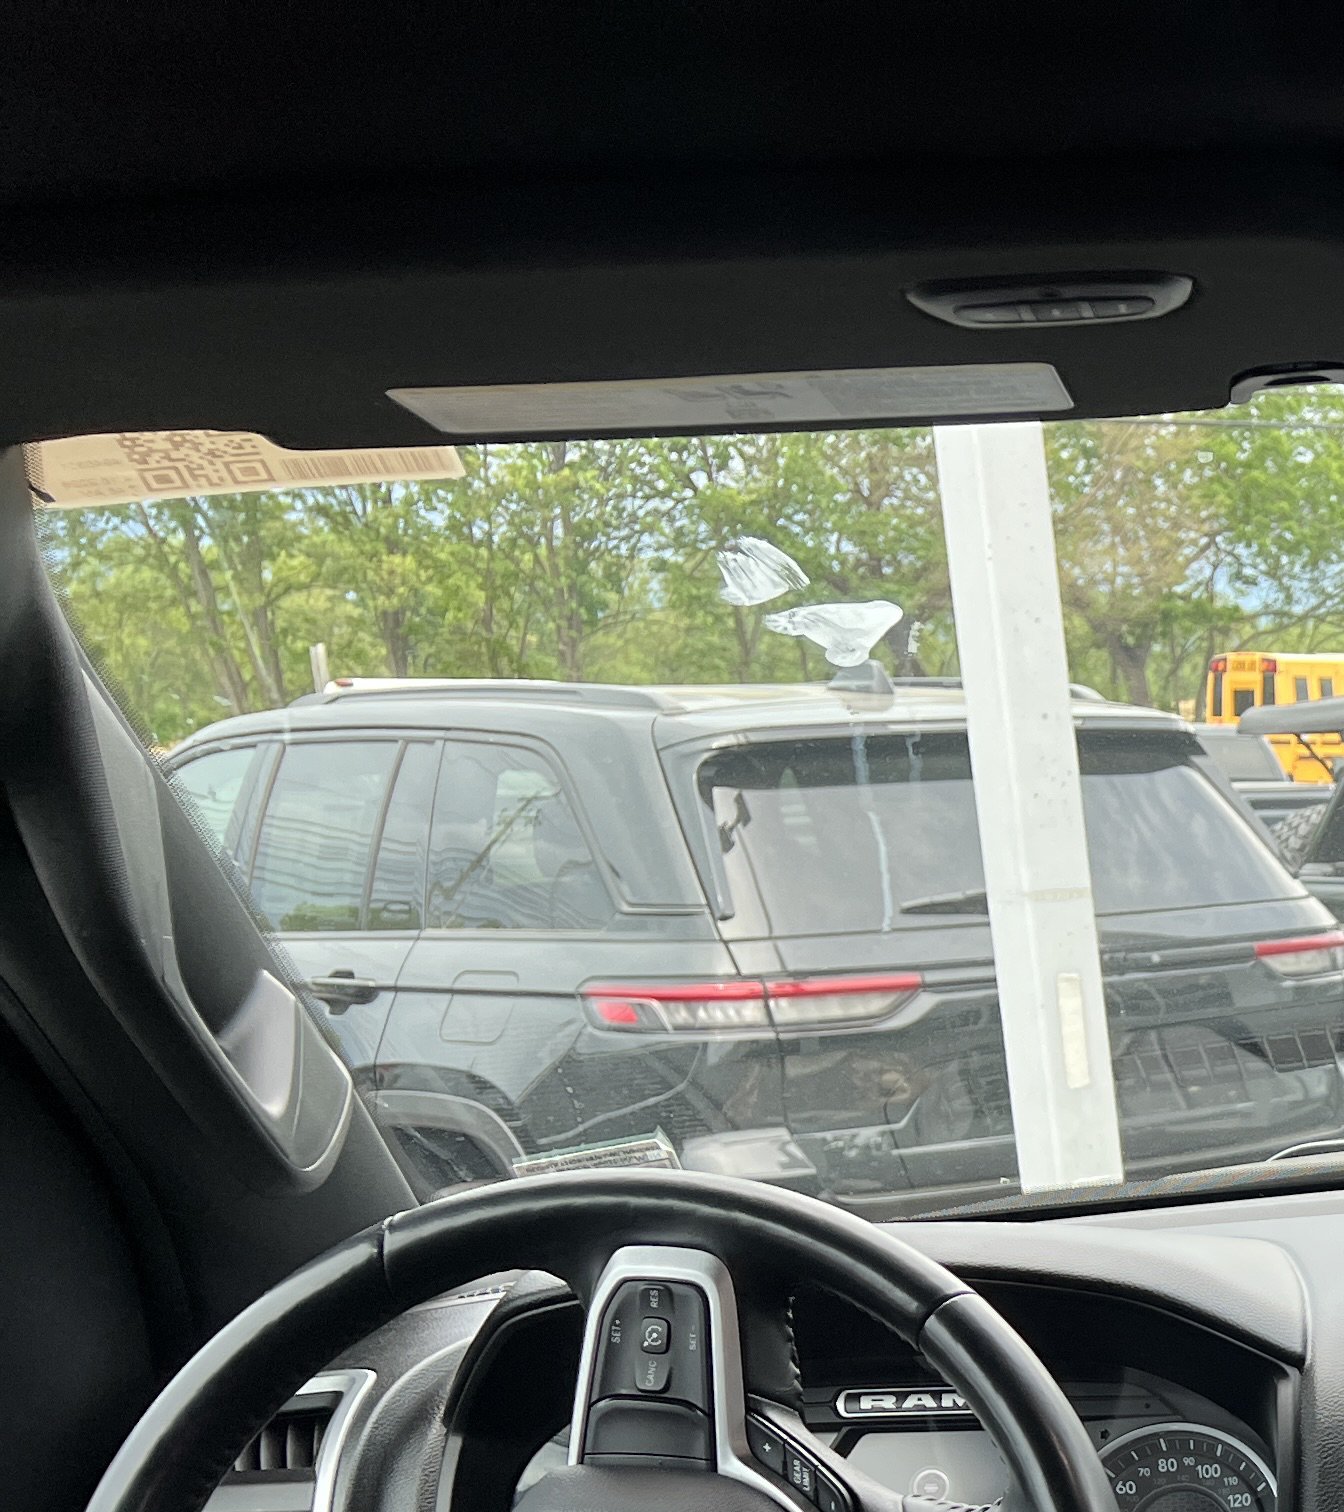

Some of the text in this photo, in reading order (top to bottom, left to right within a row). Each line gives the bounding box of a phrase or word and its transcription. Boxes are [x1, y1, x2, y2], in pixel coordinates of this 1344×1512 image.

[649, 1289, 659, 1309] RES
[645, 1360, 657, 1387] CANC
[1158, 1458, 1178, 1473] 80
[1182, 1456, 1196, 1466] 90
[1137, 1467, 1151, 1477] 70
[1195, 1463, 1222, 1479] 100
[1115, 1480, 1137, 1495] 60
[1223, 1476, 1239, 1486] 110
[1227, 1492, 1252, 1508] 120
